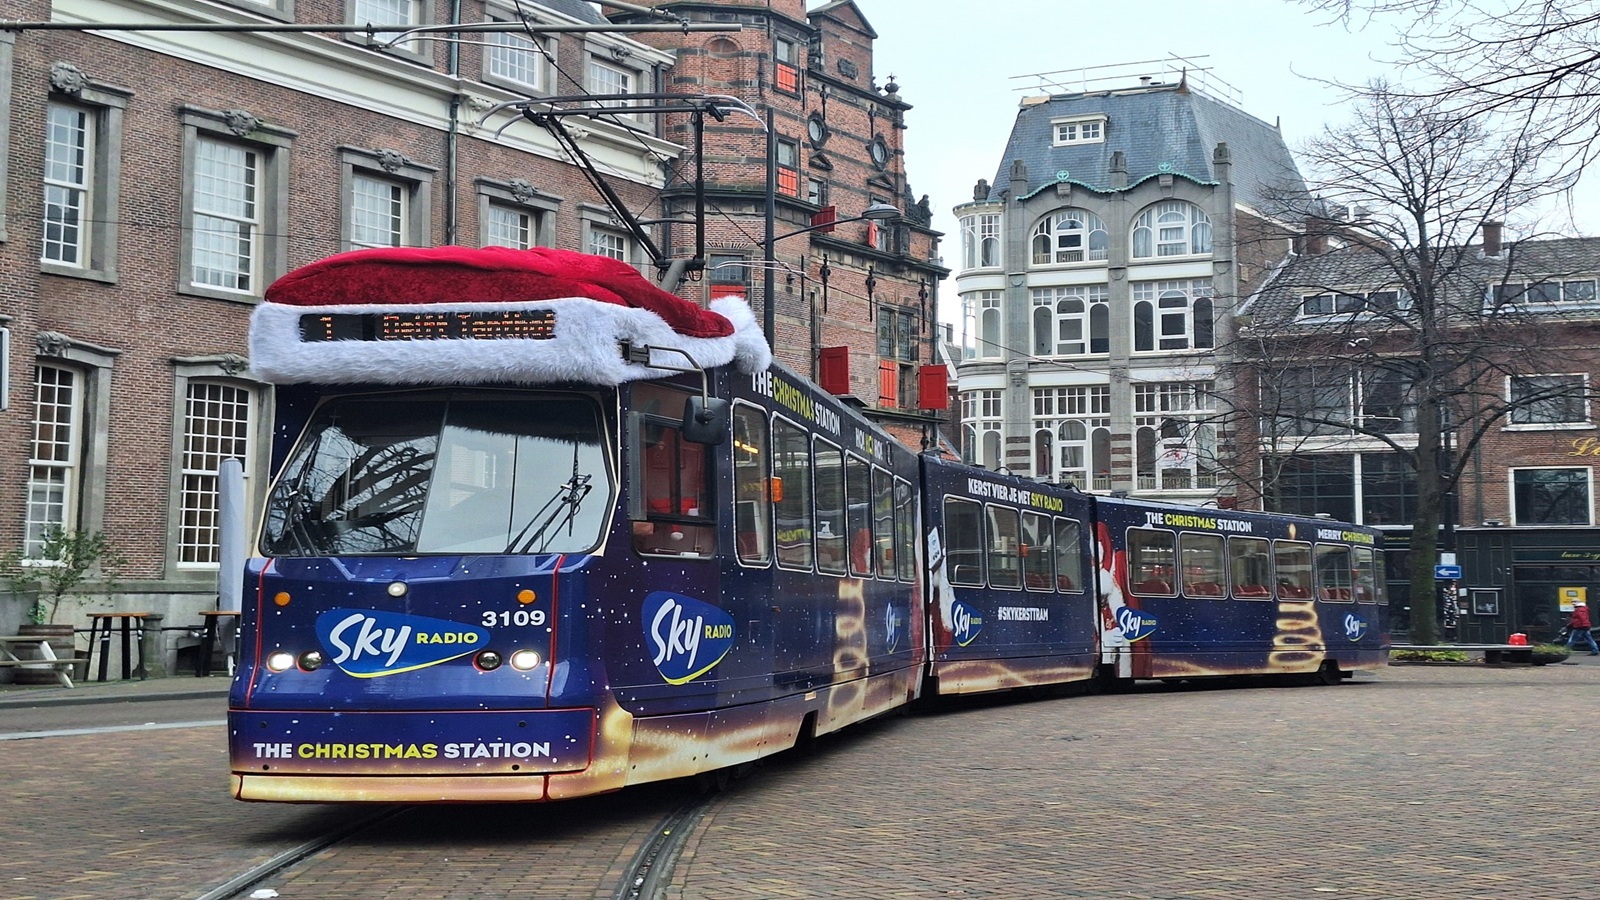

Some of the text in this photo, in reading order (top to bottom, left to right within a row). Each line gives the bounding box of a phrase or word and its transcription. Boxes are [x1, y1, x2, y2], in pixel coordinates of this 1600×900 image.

[752, 370, 841, 437] THE CHRISTMAS STATION
[968, 478, 1063, 512] KERST VIER JE MET SKY RADIO
[1145, 511, 1252, 532] THE CHRISTMAS STATION
[1317, 528, 1341, 540] MERRY
[481, 610, 546, 627] 3109
[953, 603, 971, 640] Sky
[997, 606, 1049, 621] #SKYKERSTTRAM
[1120, 609, 1141, 637] Sky
[329, 613, 478, 667] Sky RADIO
[651, 598, 732, 670] Sky RADIO
[253, 742, 551, 759] THE CHRISTMAS STATION
